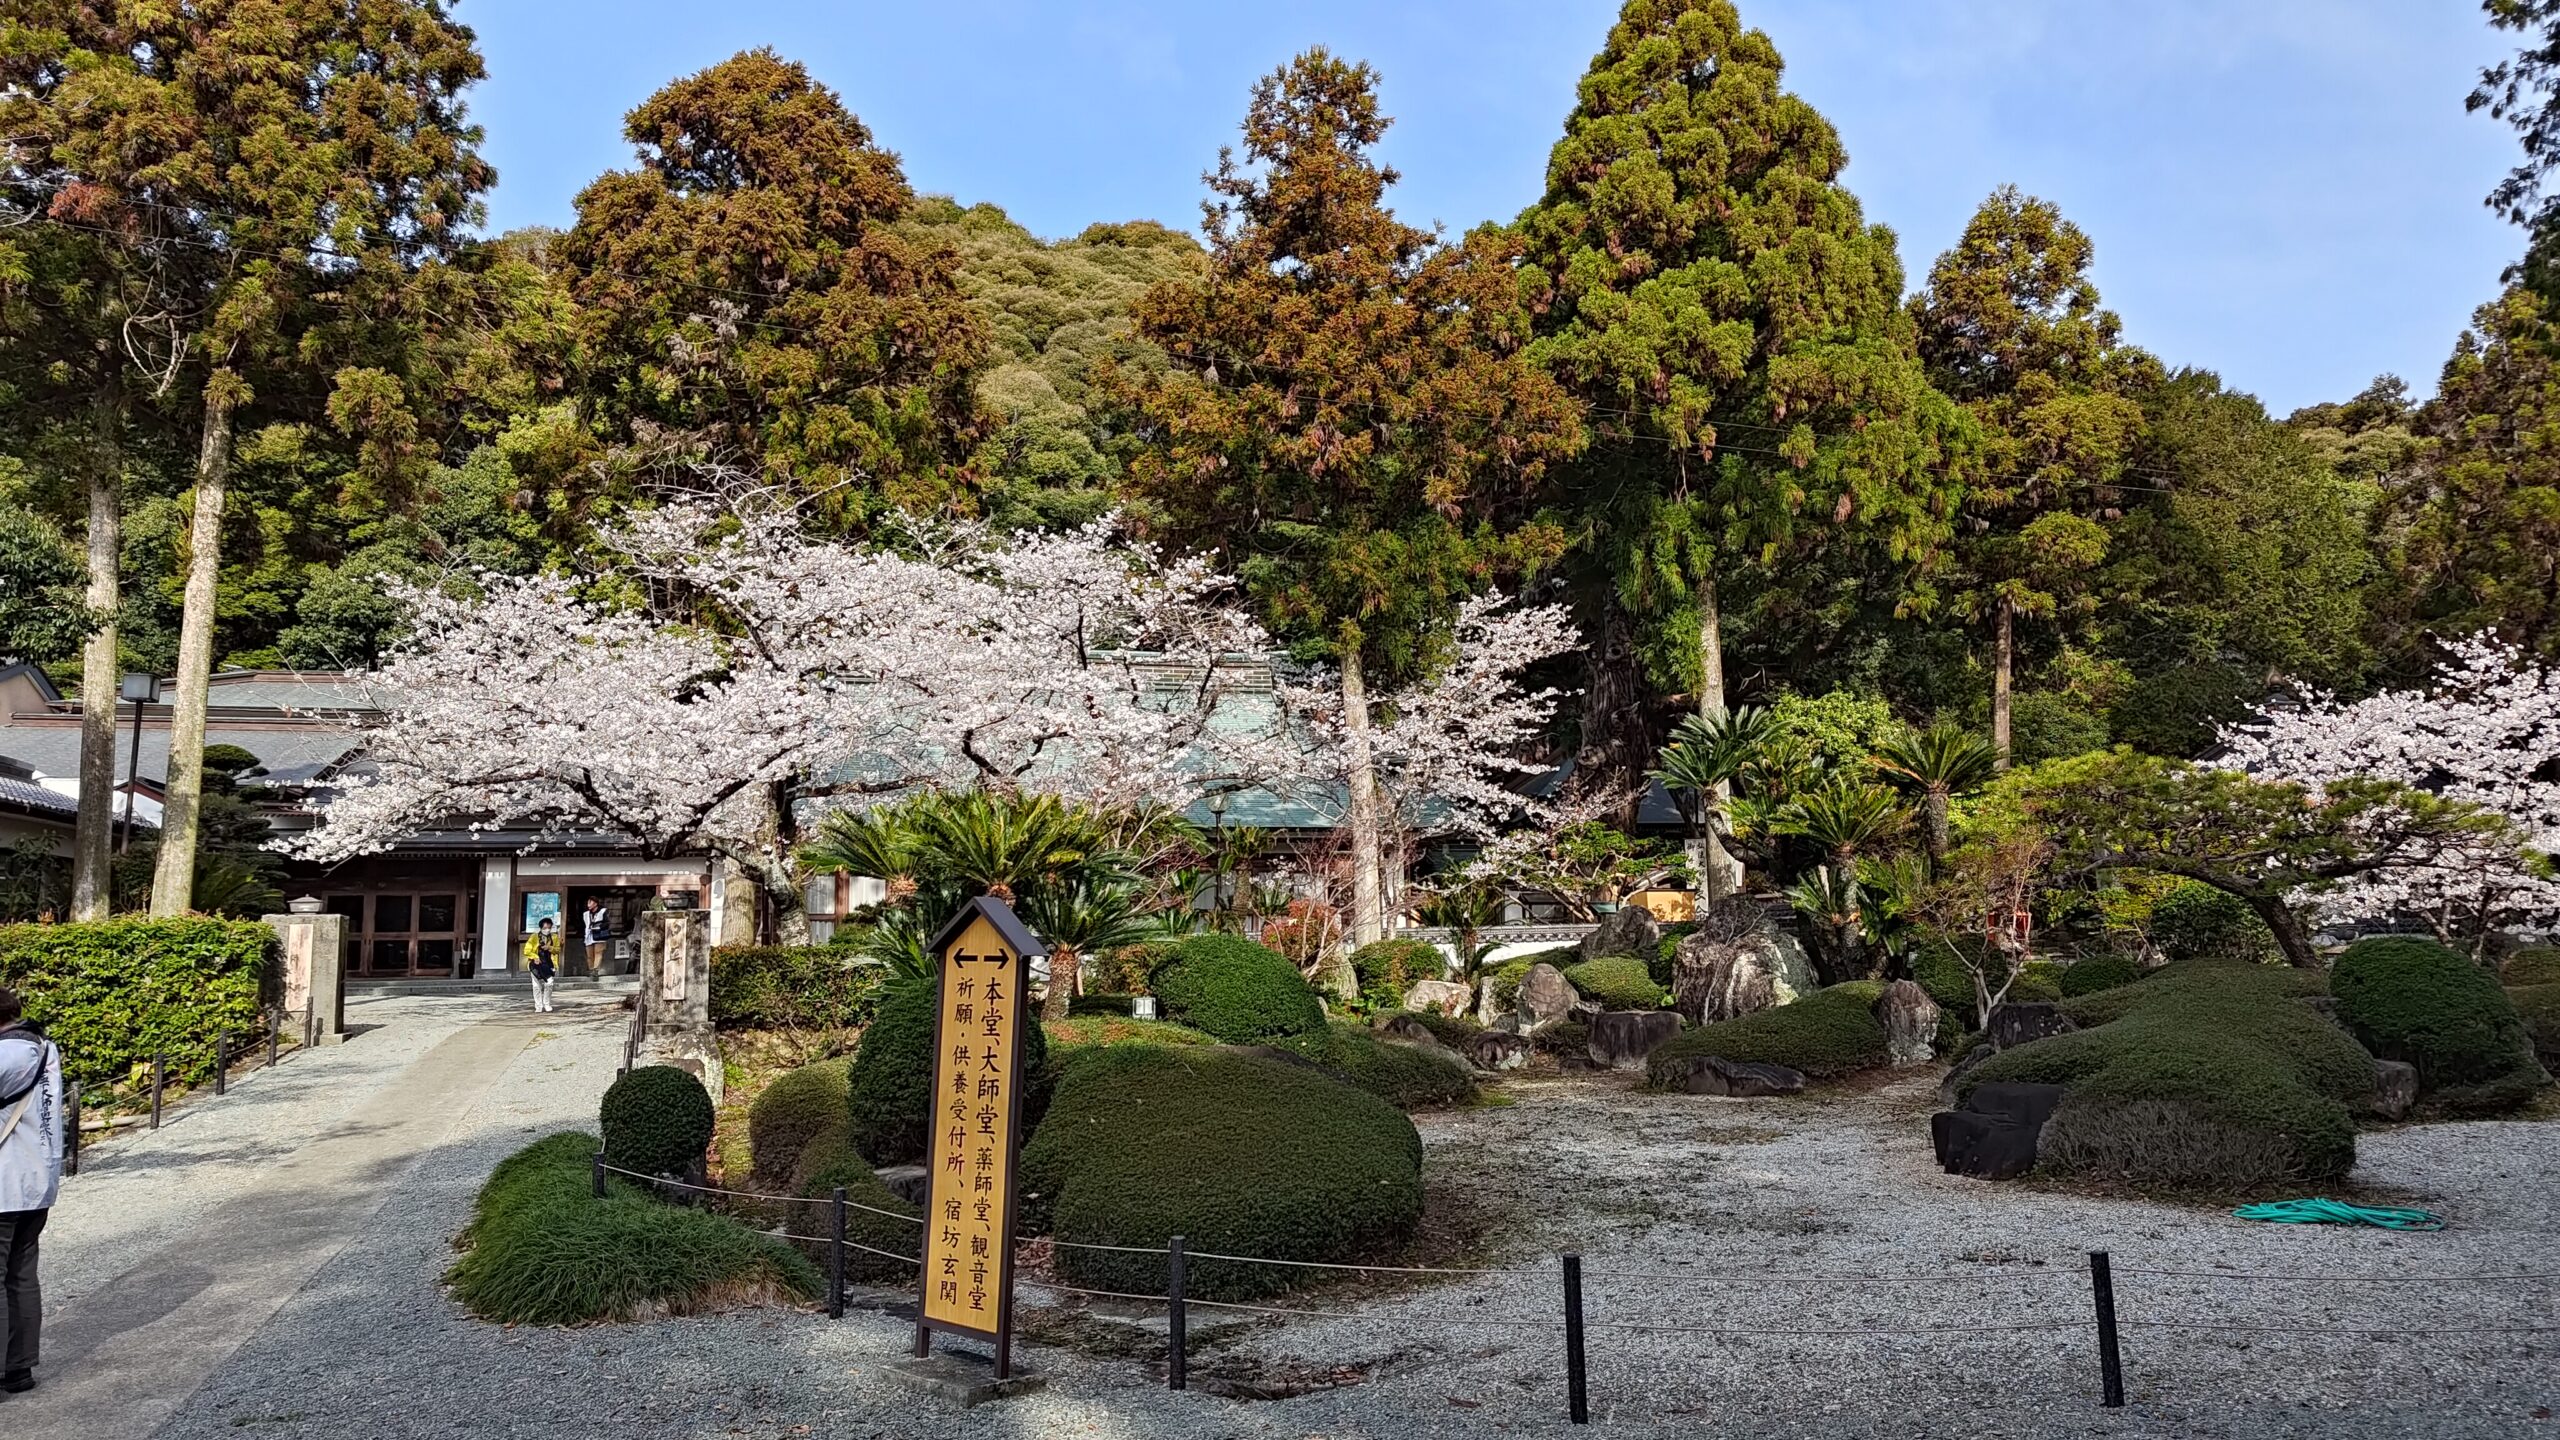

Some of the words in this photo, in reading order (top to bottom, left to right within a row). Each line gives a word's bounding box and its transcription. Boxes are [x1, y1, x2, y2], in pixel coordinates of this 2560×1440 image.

[939, 976, 975, 1306] 祈願・供養受付所、宿坊玄関
[967, 976, 1005, 1312] 本堂、大師堂、薬師堂、観音堂
